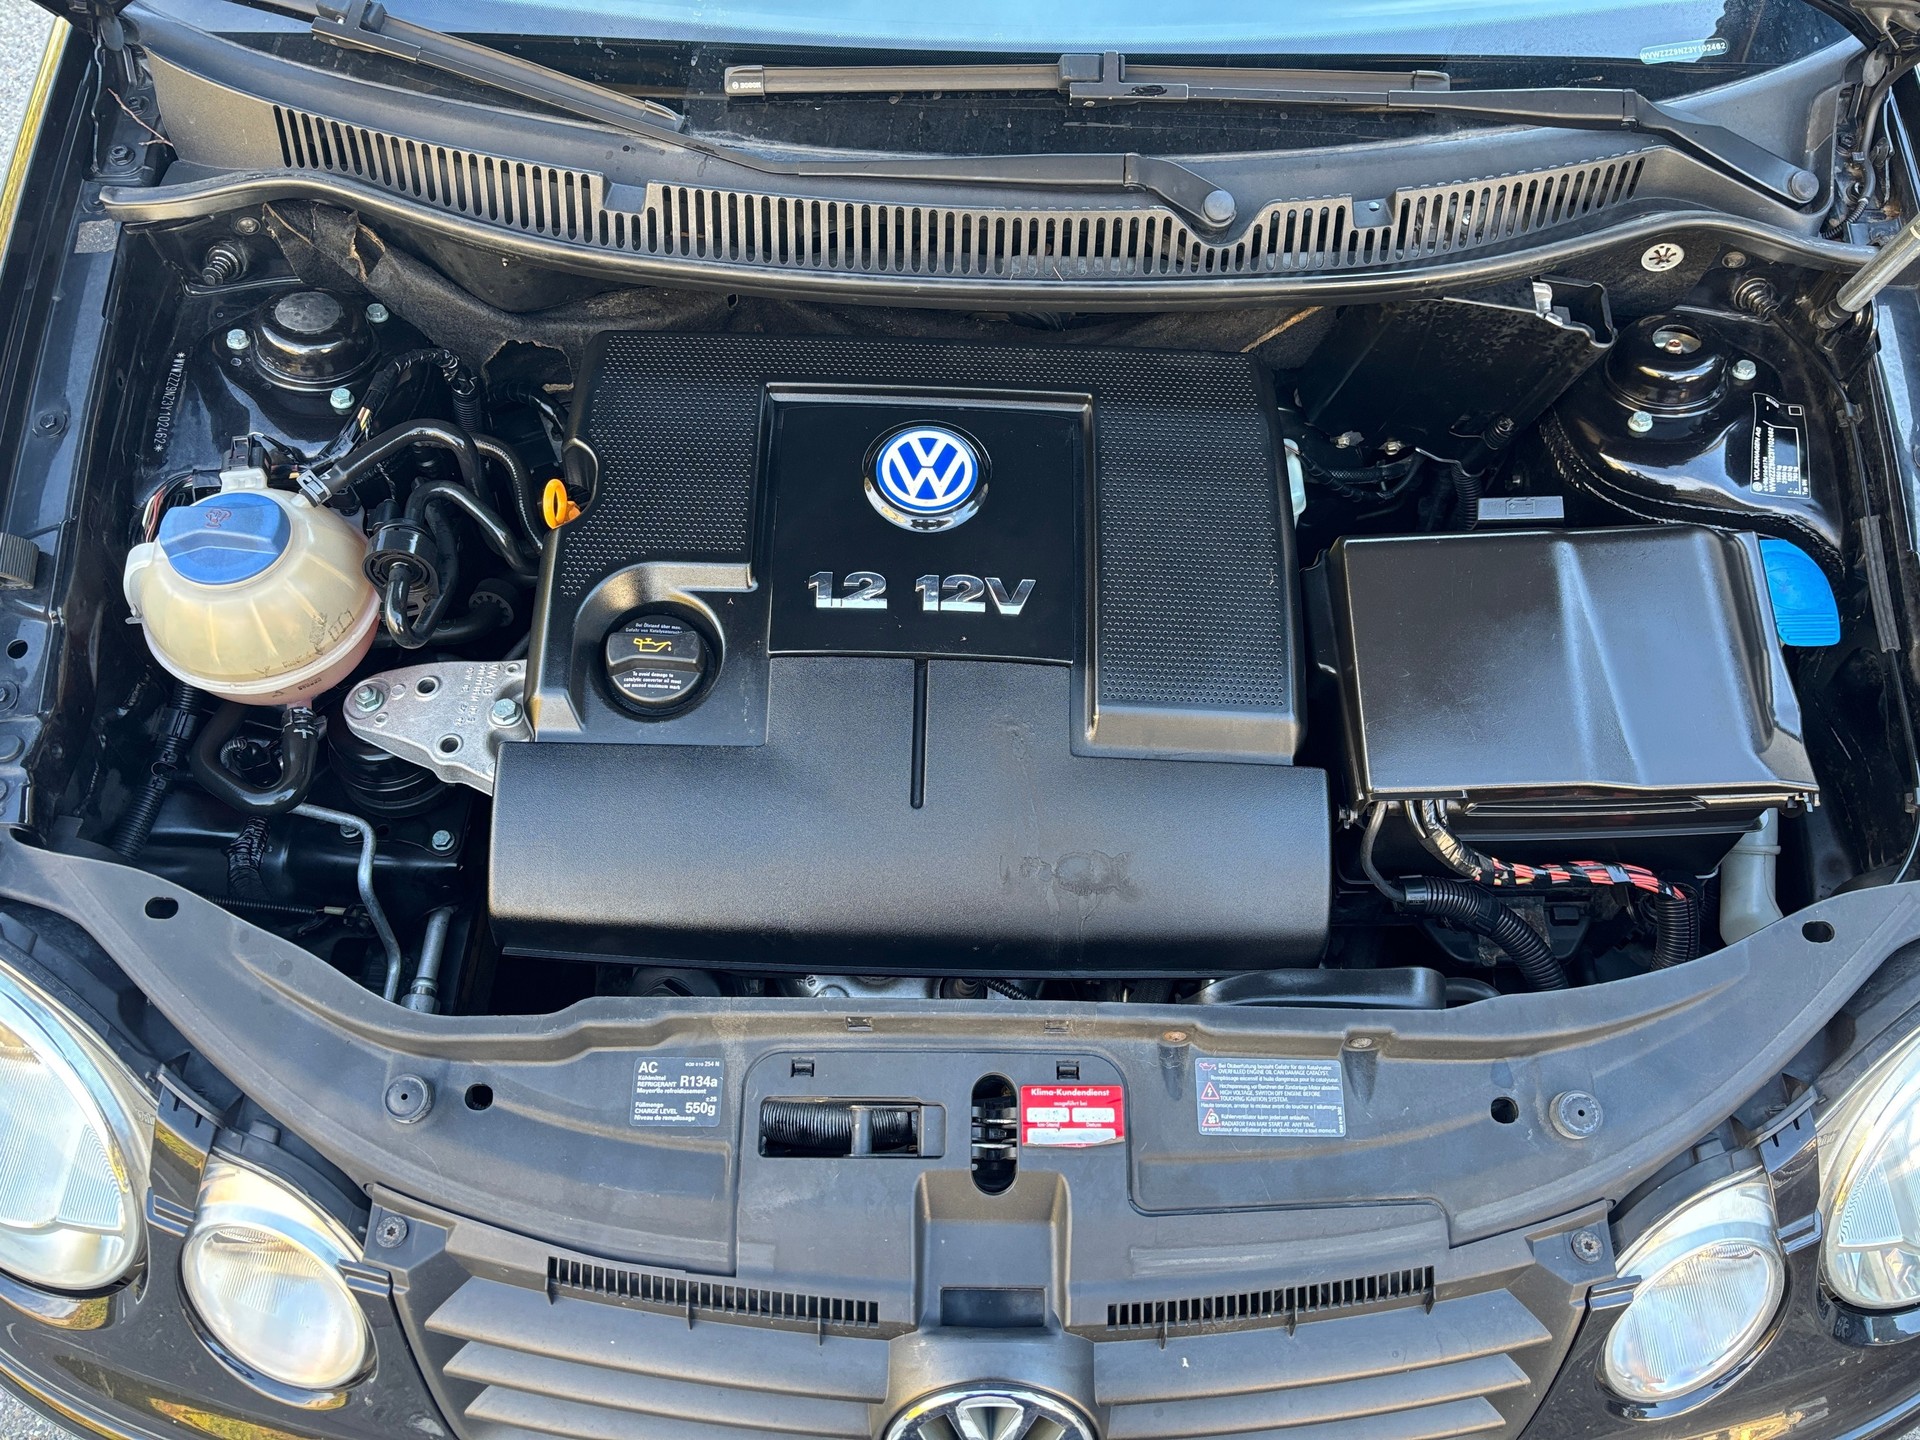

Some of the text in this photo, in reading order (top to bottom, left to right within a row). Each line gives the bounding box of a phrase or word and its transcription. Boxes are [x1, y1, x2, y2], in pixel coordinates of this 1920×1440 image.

[1755, 426, 1762, 436] AG
[914, 574, 1037, 615] 12V
[638, 1061, 658, 1073] AC
[680, 1075, 718, 1087] R134a
[1031, 1088, 1110, 1096] Klima-Kundendienst
[685, 1102, 716, 1116] 550g
